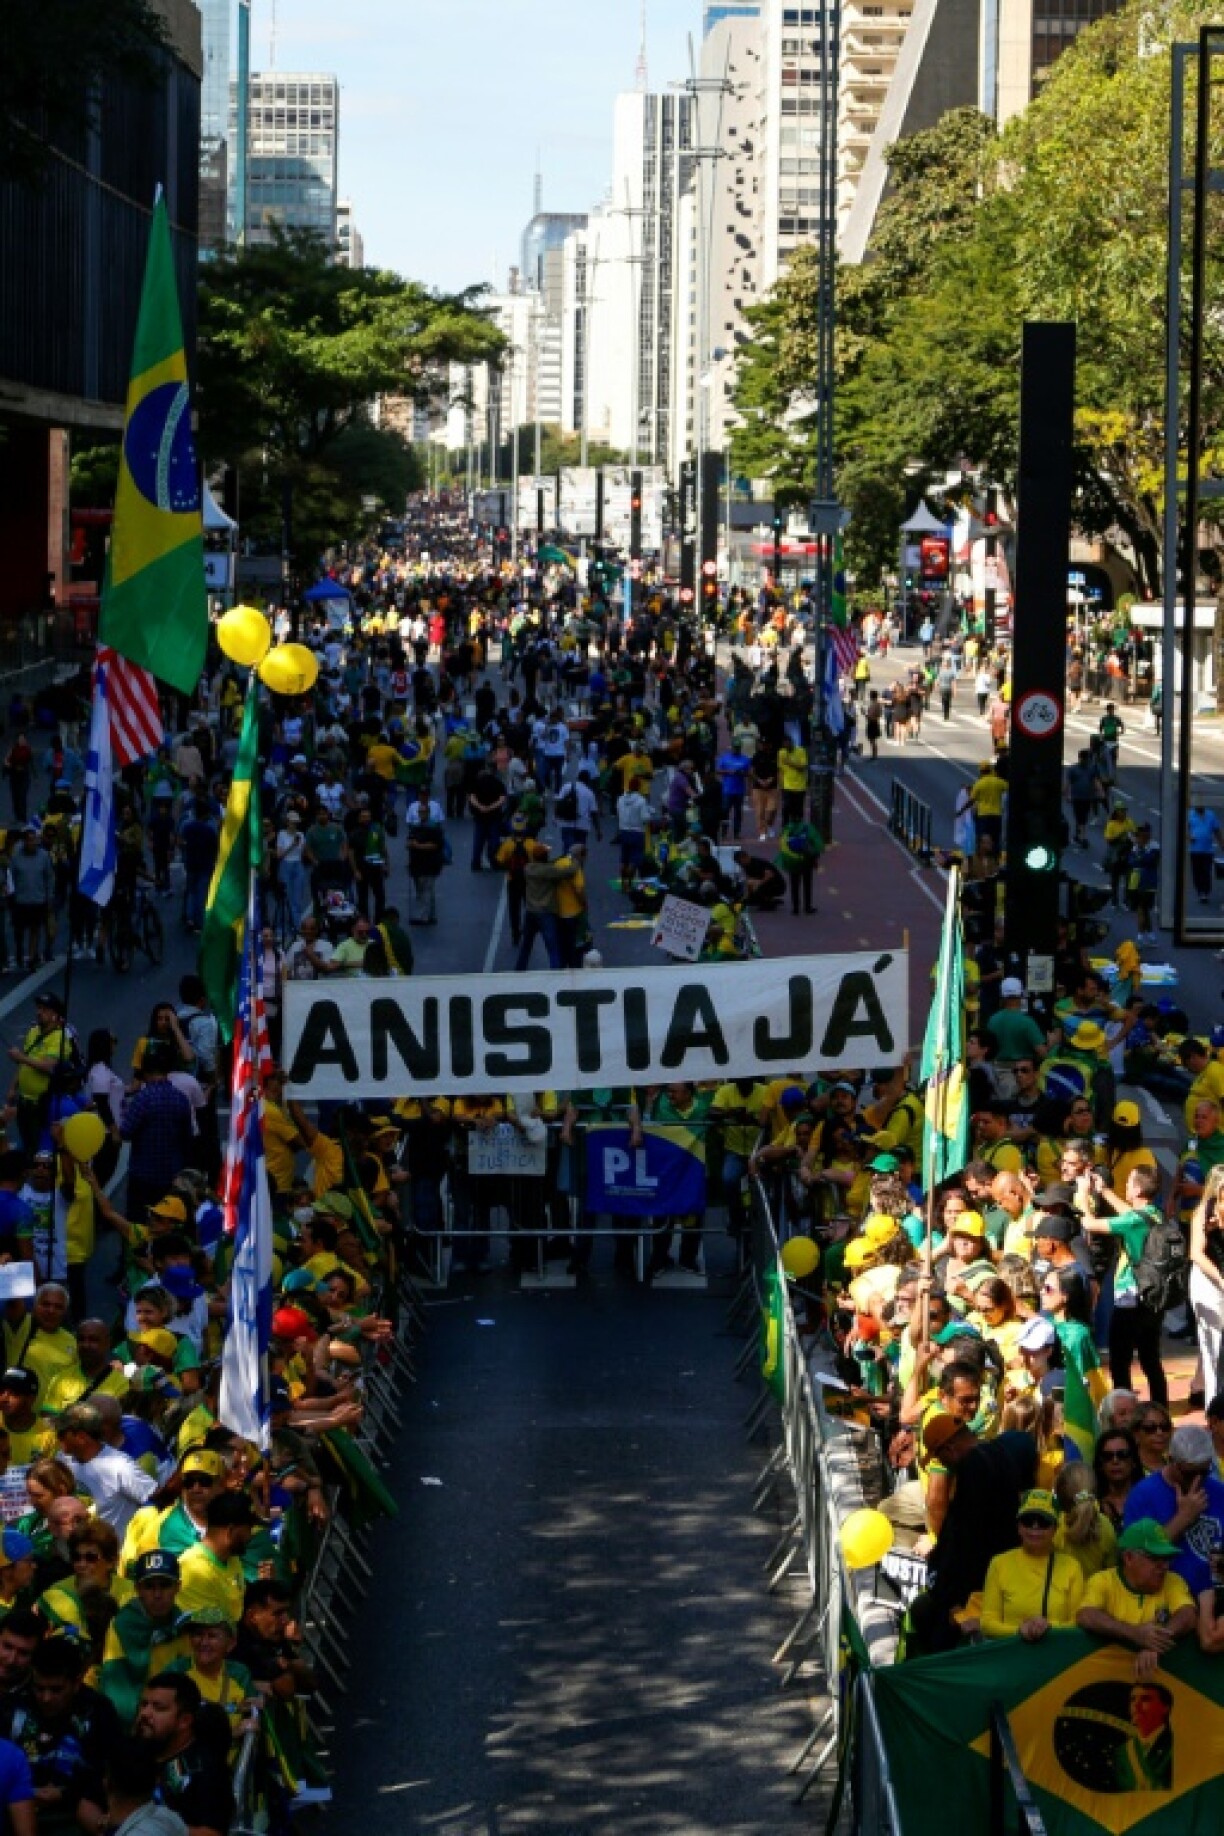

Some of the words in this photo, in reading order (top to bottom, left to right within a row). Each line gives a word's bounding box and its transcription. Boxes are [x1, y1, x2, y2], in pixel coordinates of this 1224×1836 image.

[288, 984, 730, 1084] ANISTIA
[753, 953, 895, 1060] JÁ
[604, 1147, 659, 1187] PL
